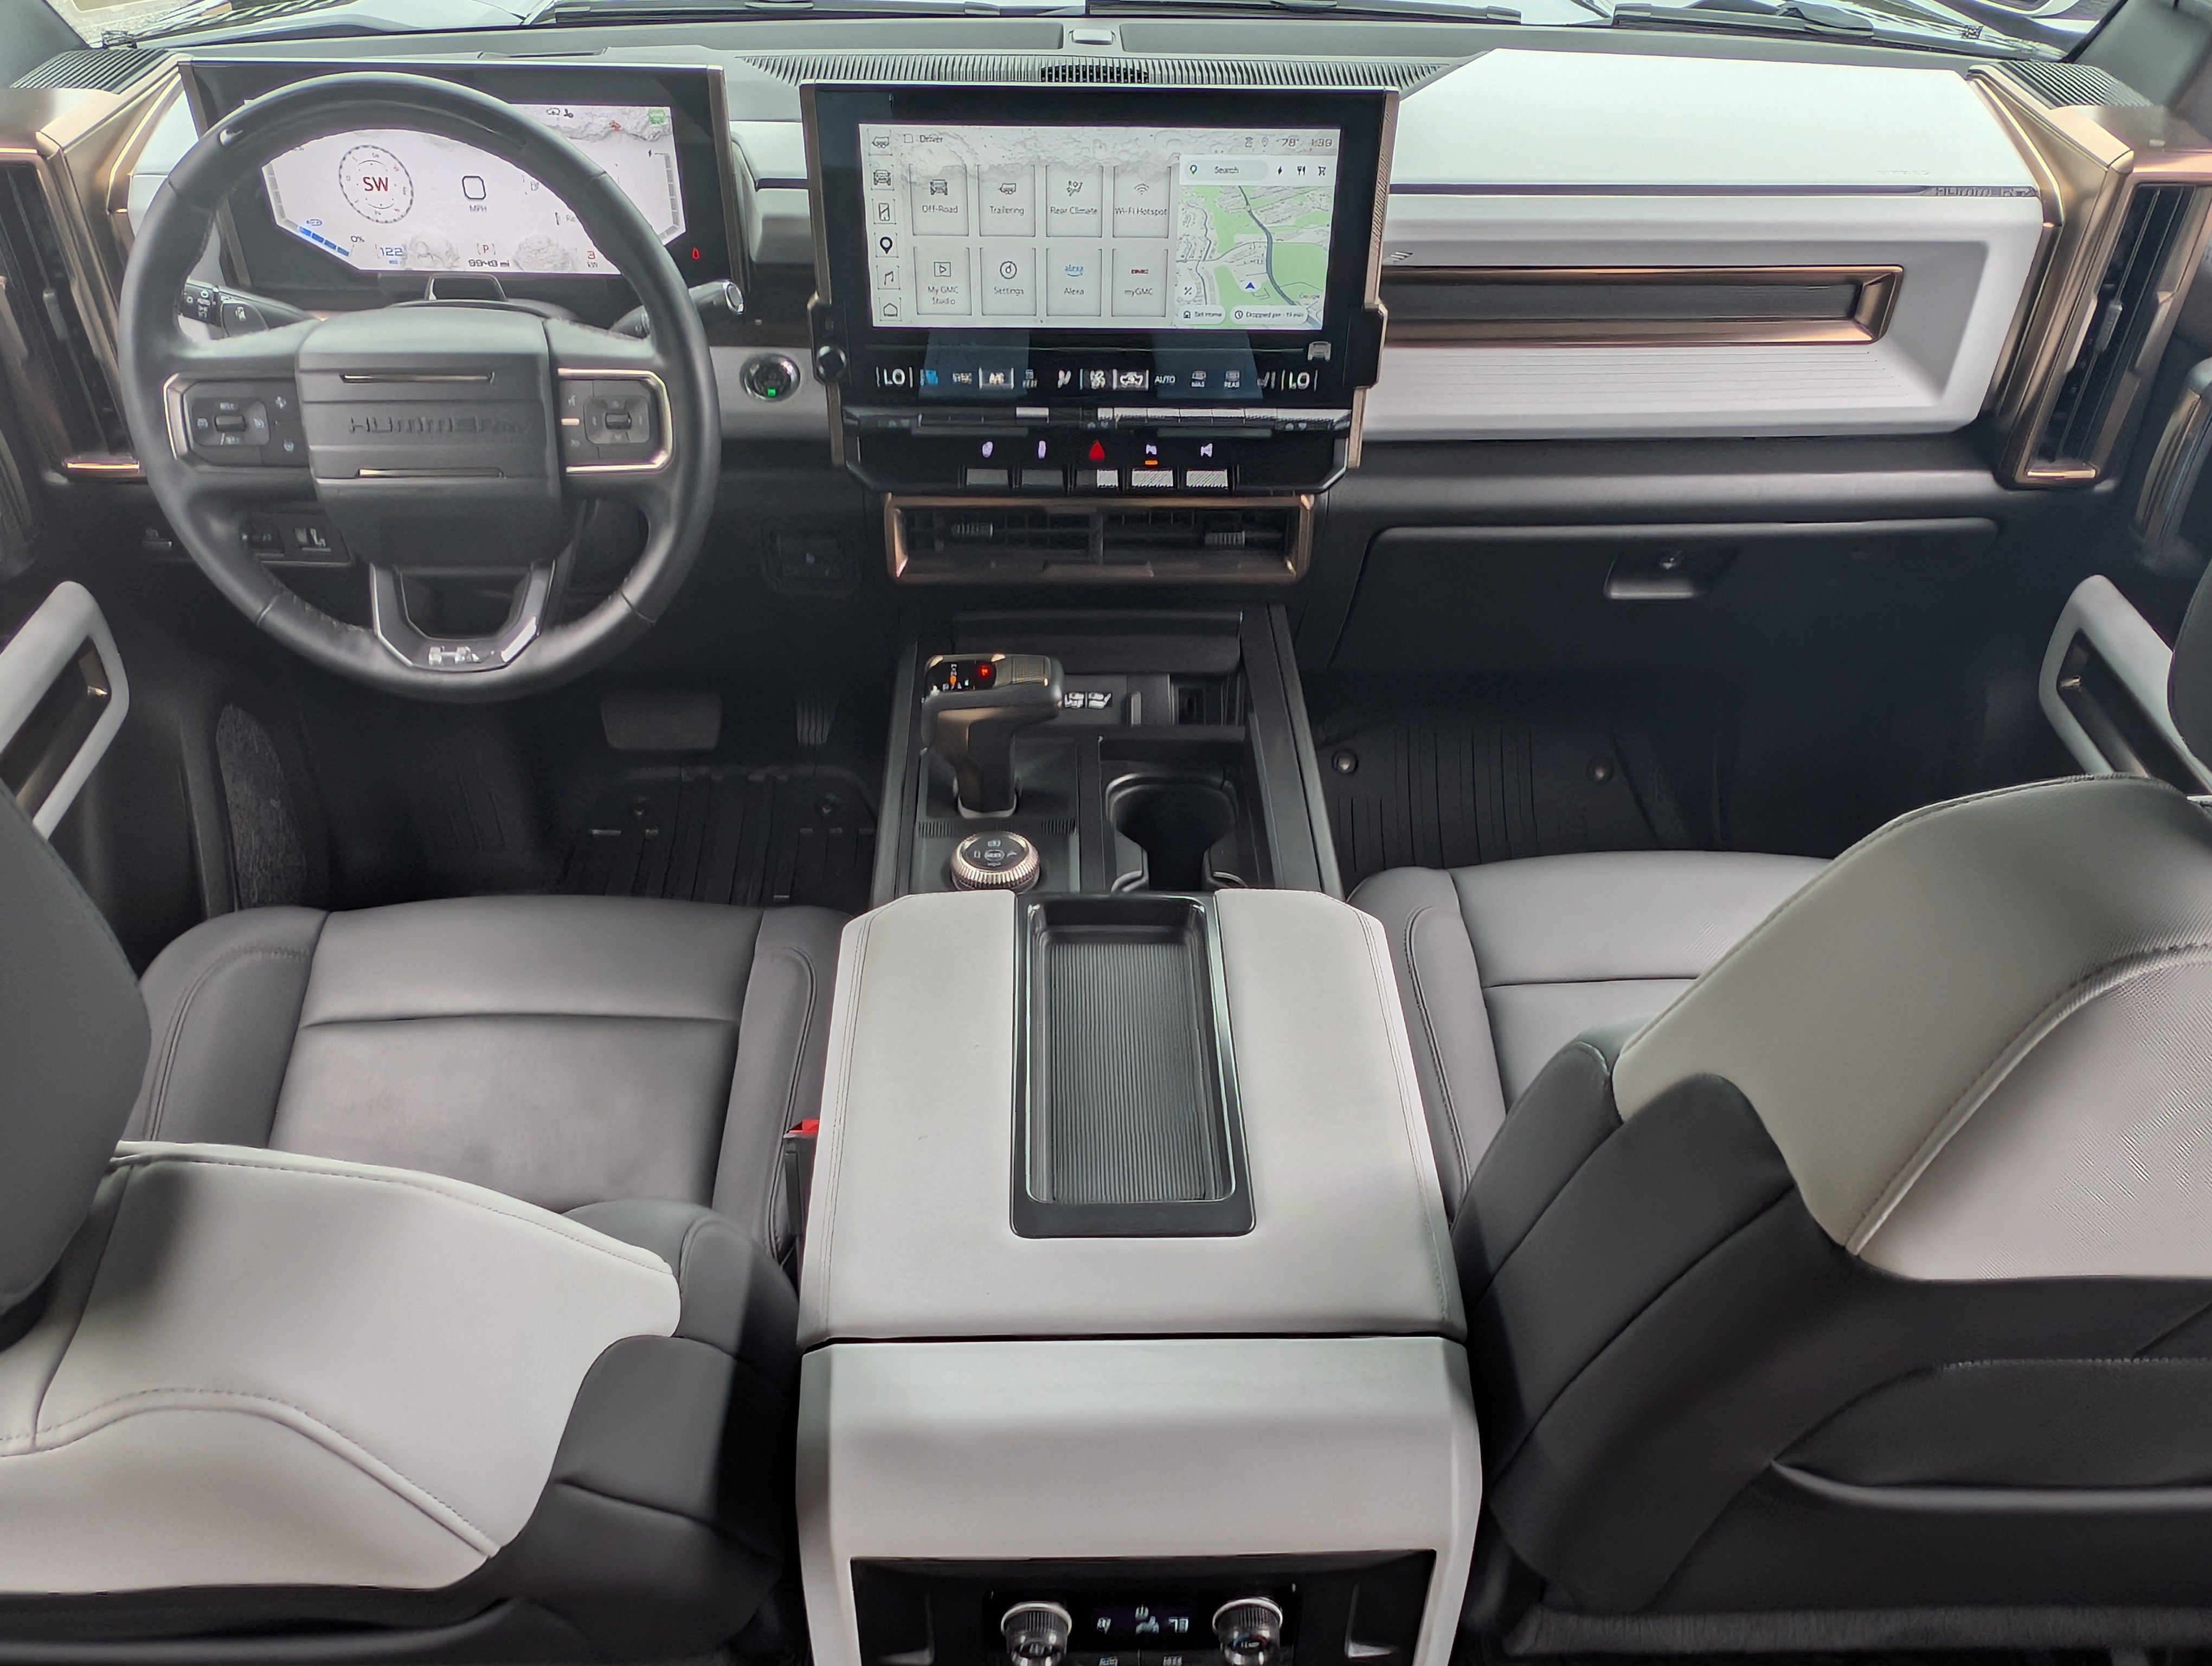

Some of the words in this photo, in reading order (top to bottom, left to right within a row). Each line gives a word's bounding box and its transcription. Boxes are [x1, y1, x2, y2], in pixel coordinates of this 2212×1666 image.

[1214, 165, 1239, 174] Search
[363, 176, 388, 191] SW
[922, 204, 959, 214] Off-Road
[989, 206, 1025, 216] Trailering
[1050, 206, 1068, 214] Rear
[1069, 206, 1098, 215] Climate
[1115, 207, 1135, 215] Wi-Fi
[1136, 207, 1167, 216] Hotspot
[379, 247, 404, 257] 122
[483, 244, 489, 254] P
[994, 286, 1024, 297] Settings
[883, 368, 905, 385] LO
[1154, 375, 1176, 383] AUTO
[1289, 371, 1310, 389] LO
[350, 416, 492, 433] HUMMER
